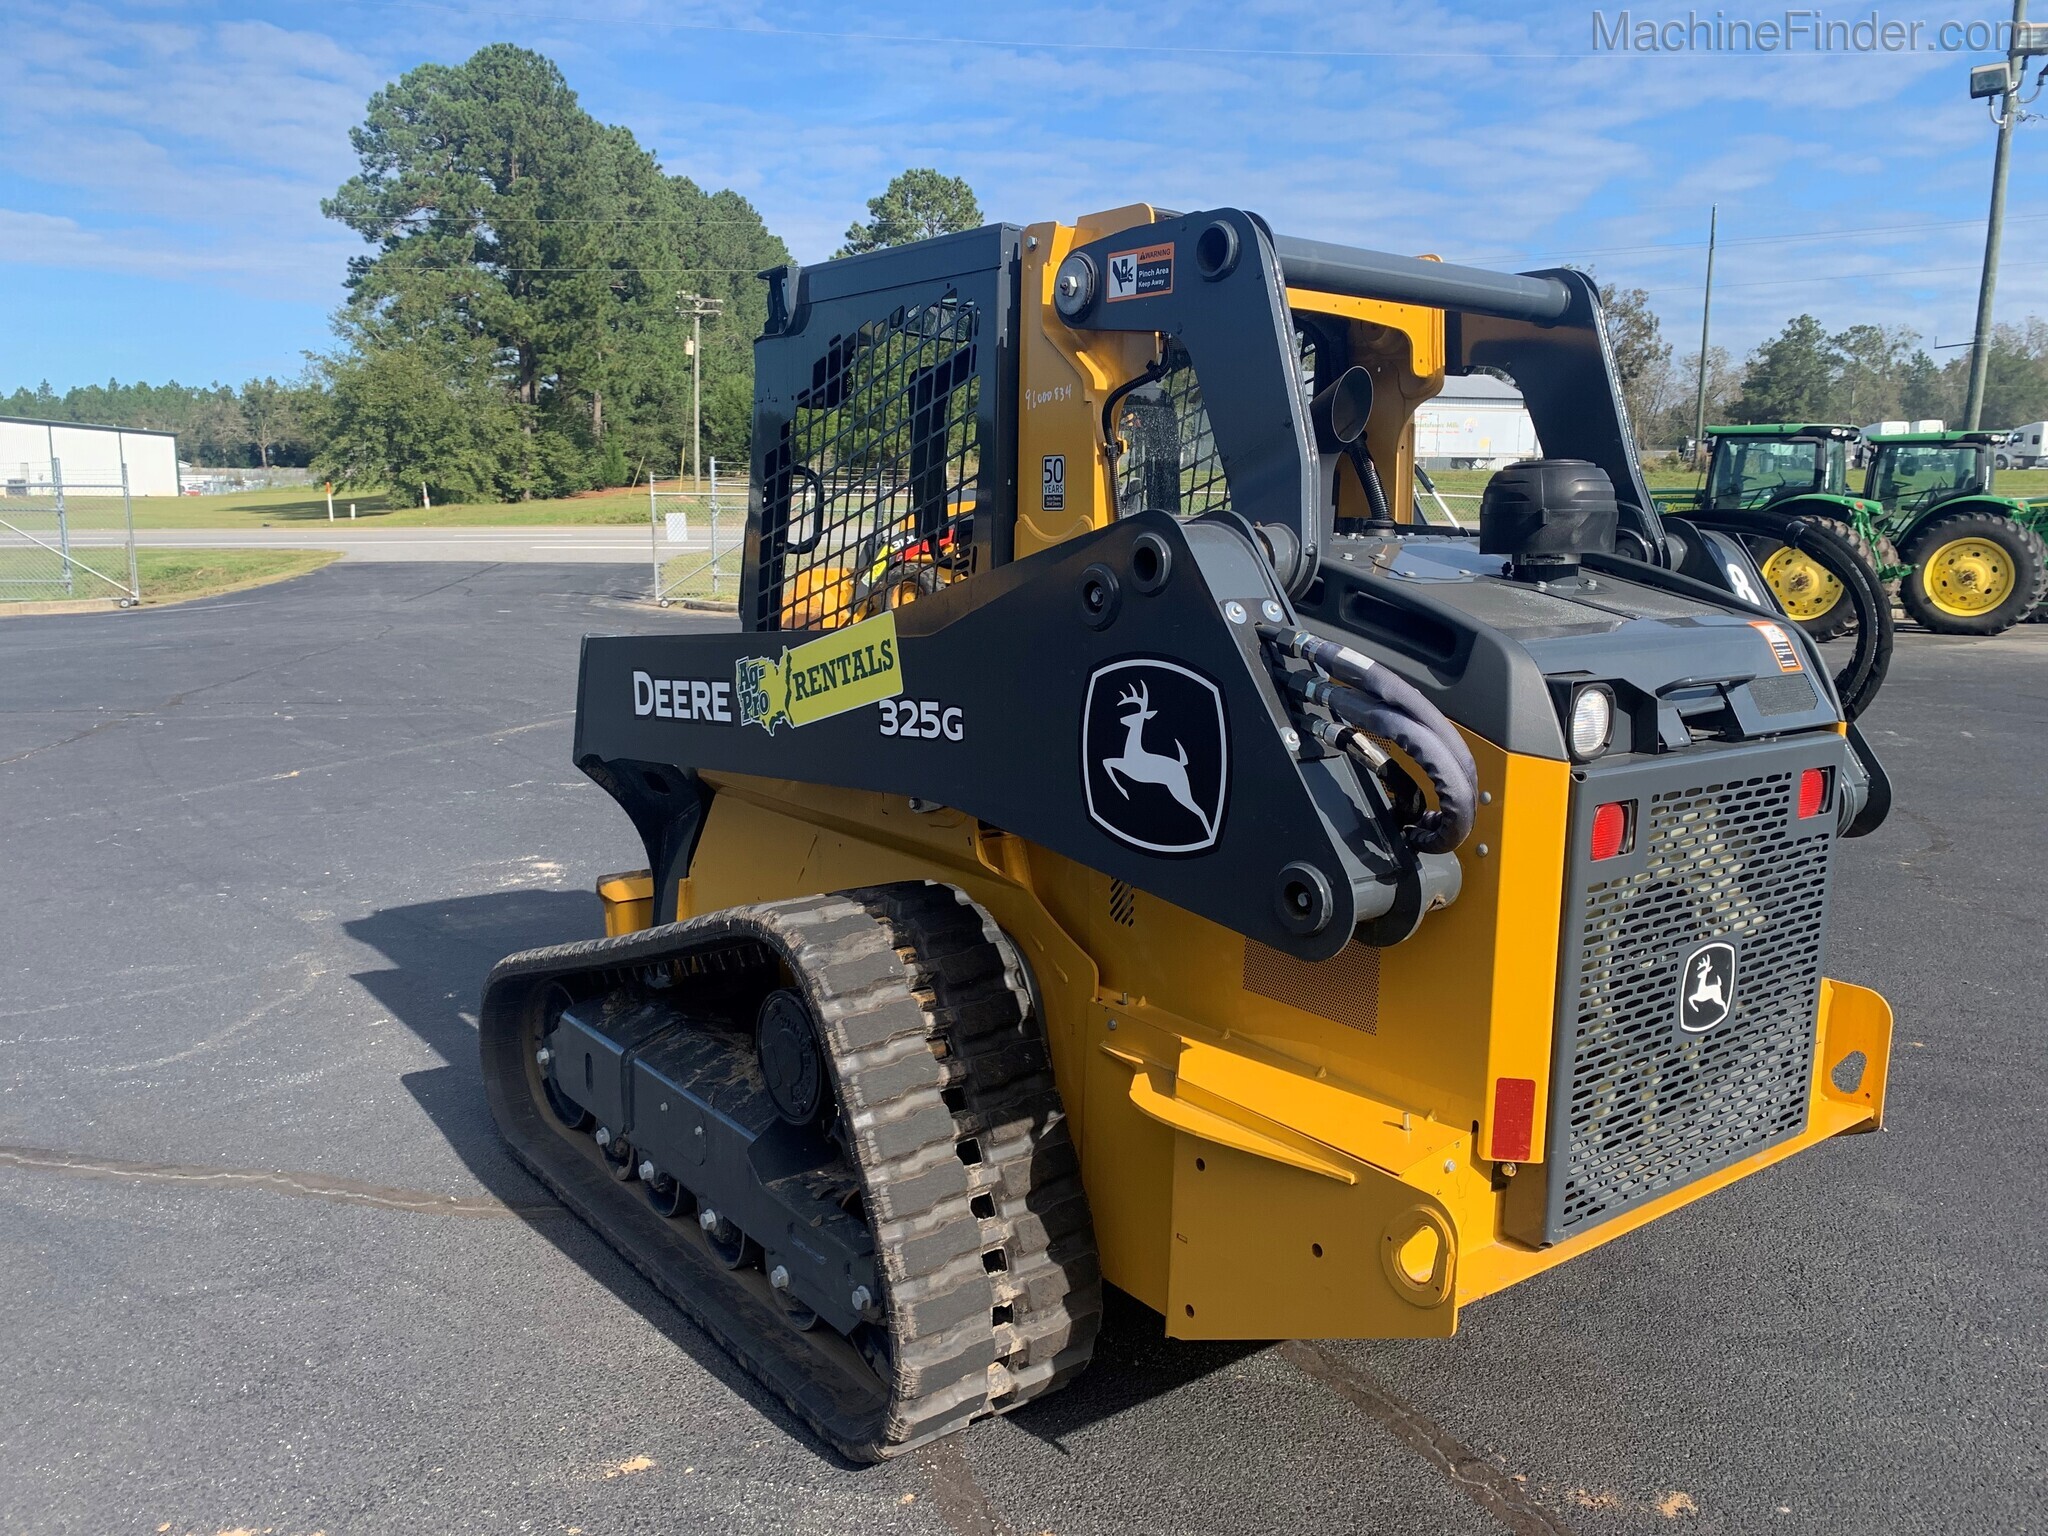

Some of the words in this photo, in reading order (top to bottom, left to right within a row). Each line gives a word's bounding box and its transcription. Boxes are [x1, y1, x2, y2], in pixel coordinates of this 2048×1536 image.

[1145, 248, 1170, 258] WARNING
[1138, 269, 1155, 278] Pinch
[1155, 267, 1169, 276] Area
[1044, 458, 1063, 484] 50
[1044, 484, 1063, 494] YEARS
[792, 638, 894, 702] RENTALS
[632, 670, 732, 723] DEERE
[878, 700, 964, 741] 325G
